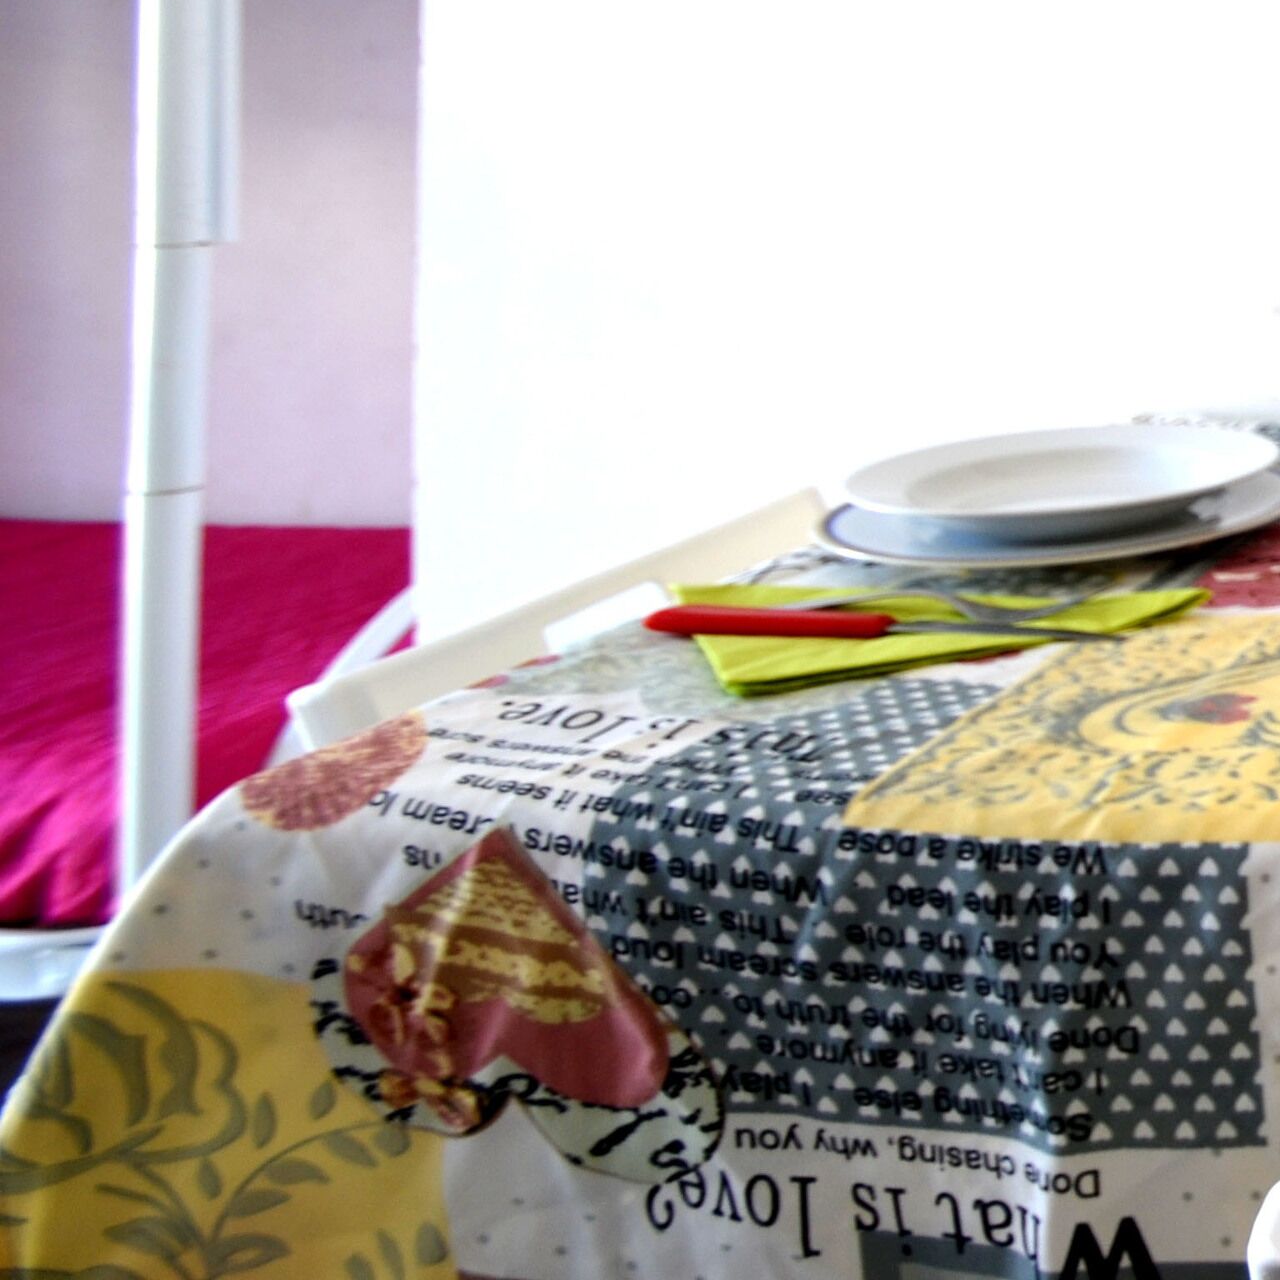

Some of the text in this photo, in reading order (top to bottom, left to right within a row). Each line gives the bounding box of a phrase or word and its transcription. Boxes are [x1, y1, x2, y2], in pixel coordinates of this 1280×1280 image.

[497, 701, 638, 744] love.
[456, 773, 552, 803] seems
[553, 789, 577, 812] it
[580, 793, 655, 824] what
[523, 828, 657, 871] answers
[736, 818, 800, 854] This
[955, 841, 1042, 871] strike
[667, 856, 719, 894] the
[729, 871, 826, 907] When
[963, 891, 1012, 919] the
[1025, 890, 1089, 921] play
[718, 908, 794, 945] This
[845, 925, 905, 951] role
[976, 932, 1040, 966] play
[609, 936, 1132, 1007] When the answers scream loud
[755, 1034, 900, 1069] anymore
[1048, 1026, 1141, 1056] Done
[852, 1089, 920, 1111] else
[735, 1124, 1101, 1200] Done chasing, why you
[643, 1169, 1160, 1280] What is love?
